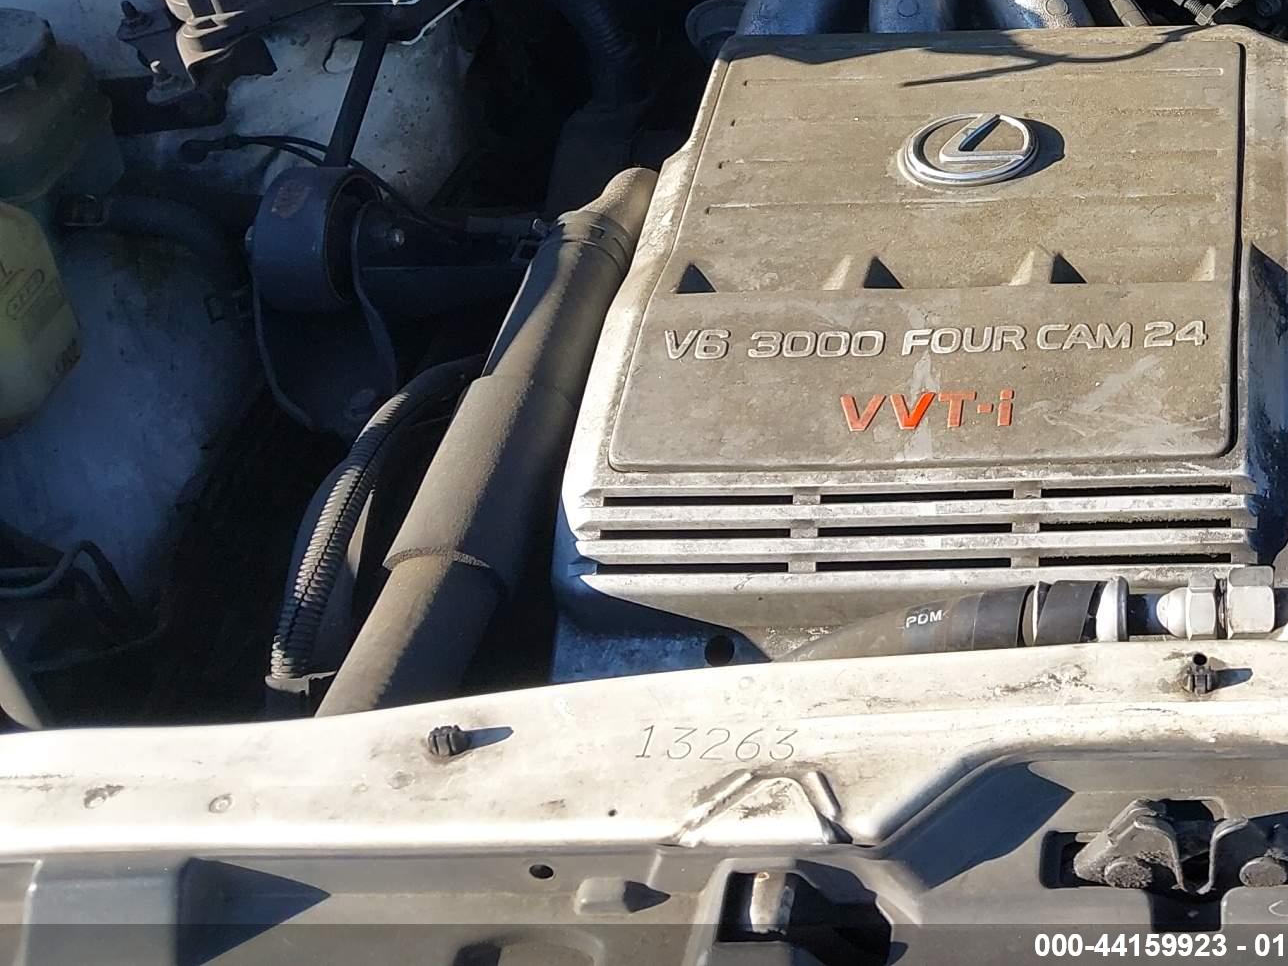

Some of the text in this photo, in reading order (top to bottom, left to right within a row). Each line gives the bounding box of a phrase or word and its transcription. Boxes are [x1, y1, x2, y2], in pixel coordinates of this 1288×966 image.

[664, 319, 1209, 360] V6 3000 FOUR CAM 24
[839, 389, 1016, 433] VVT-i
[634, 724, 799, 762] 13263
